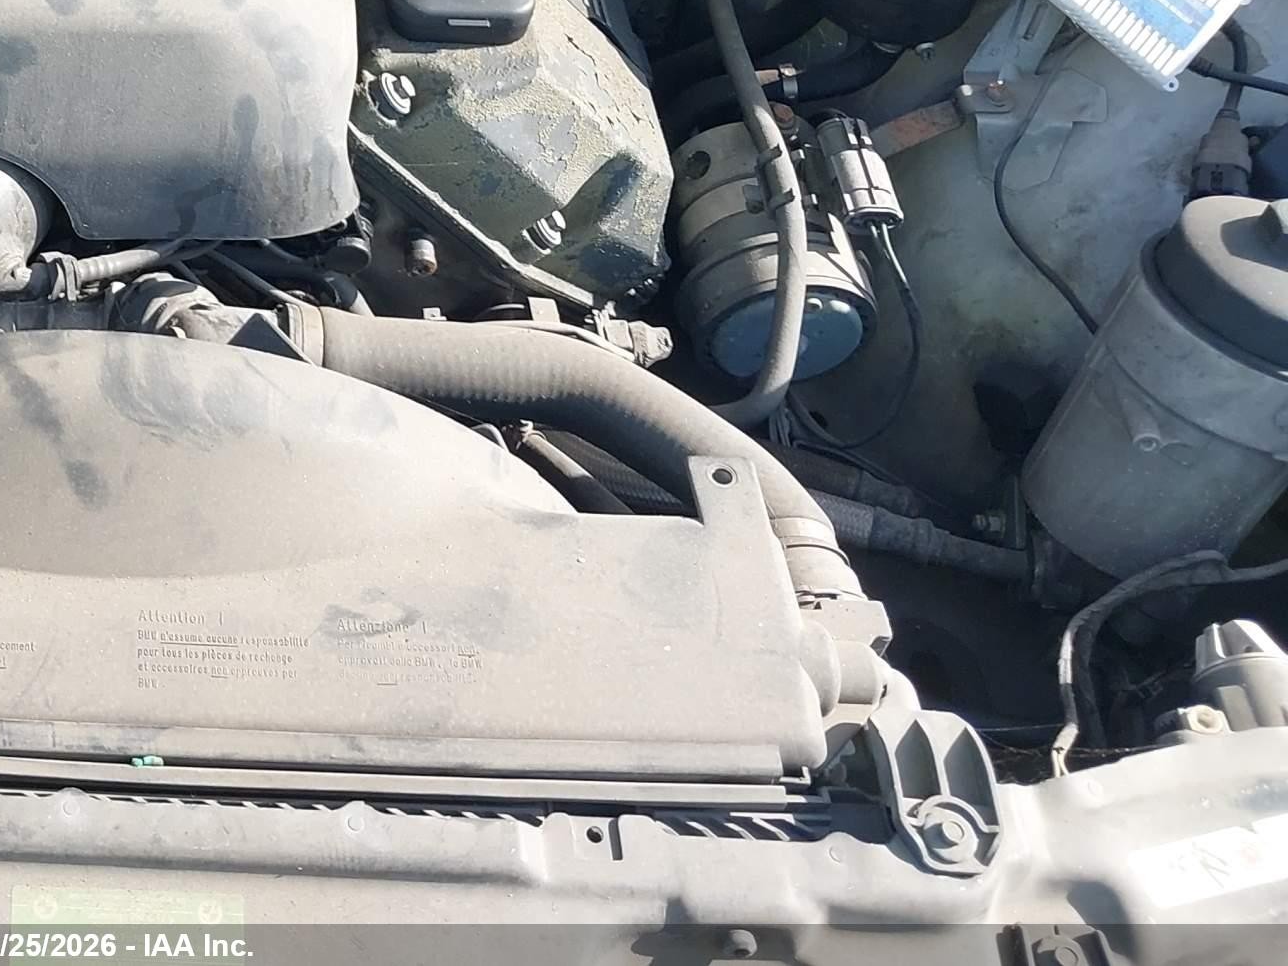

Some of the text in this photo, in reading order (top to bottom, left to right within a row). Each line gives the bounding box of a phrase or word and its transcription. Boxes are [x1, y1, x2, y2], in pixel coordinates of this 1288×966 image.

[138, 610, 205, 624] Attention
[138, 630, 158, 640] BMW
[137, 648, 158, 659] pour
